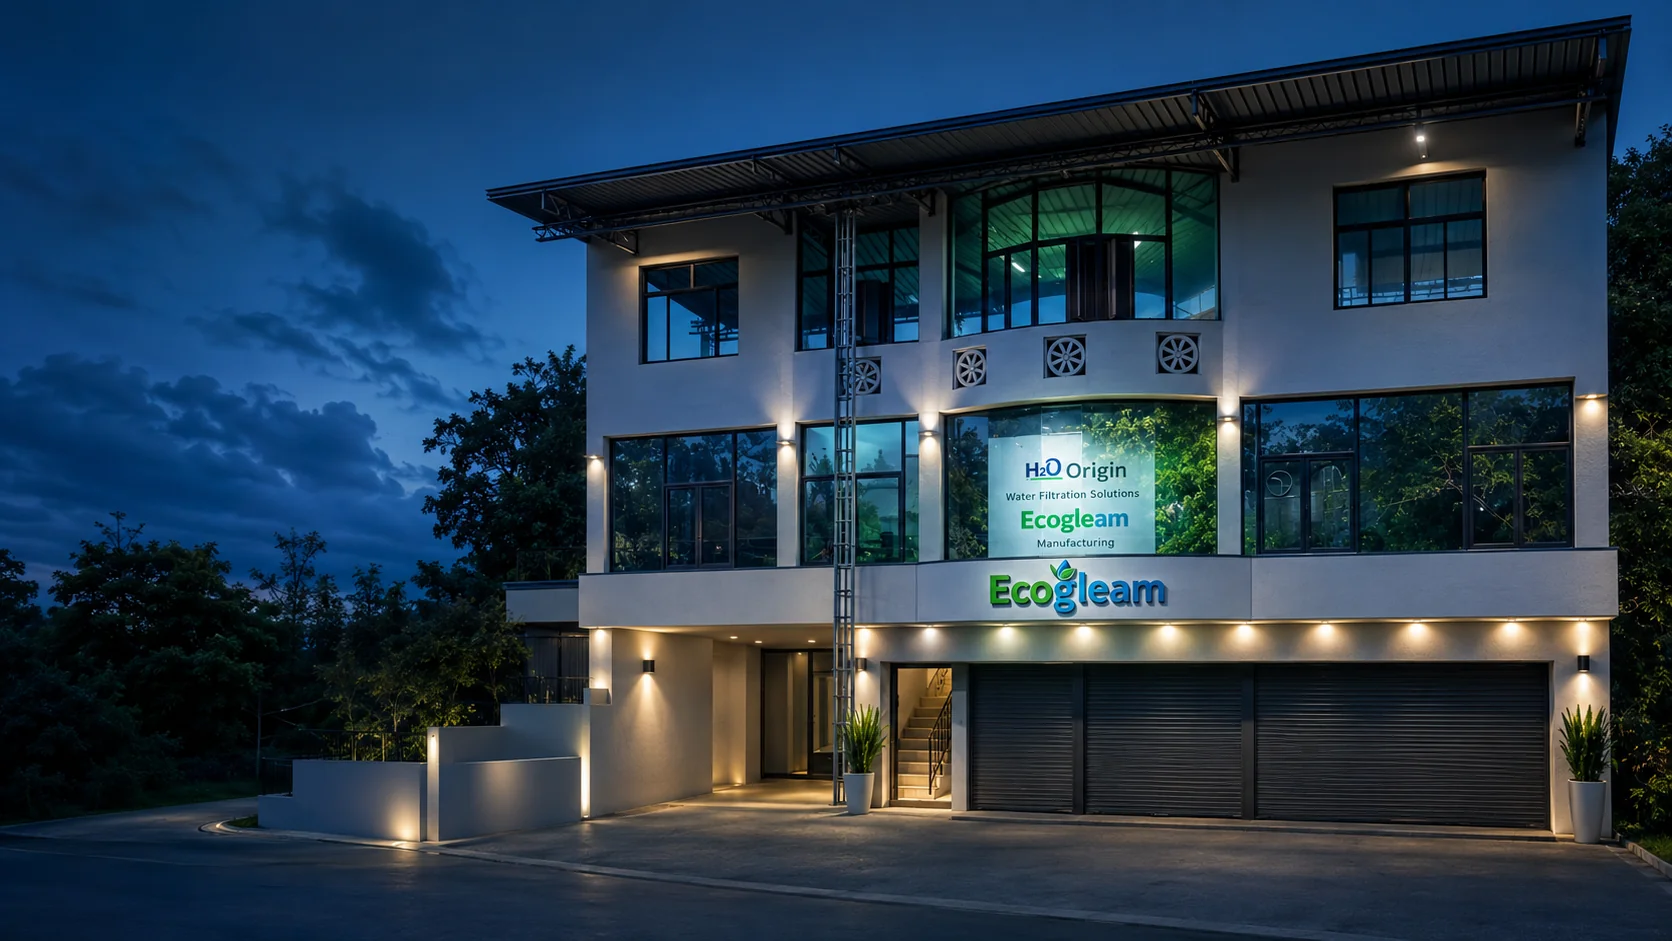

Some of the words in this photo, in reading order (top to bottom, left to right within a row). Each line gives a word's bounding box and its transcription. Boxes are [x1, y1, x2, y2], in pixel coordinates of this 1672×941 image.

[1066, 461, 1127, 482] Origin
[1006, 491, 1036, 501] Water
[1039, 490, 1087, 500] Filtration
[1090, 488, 1140, 499] Solutions
[1021, 508, 1129, 533] Ecogleam
[1037, 538, 1115, 549] Manufacturing
[989, 571, 1166, 614] Ecogleam
